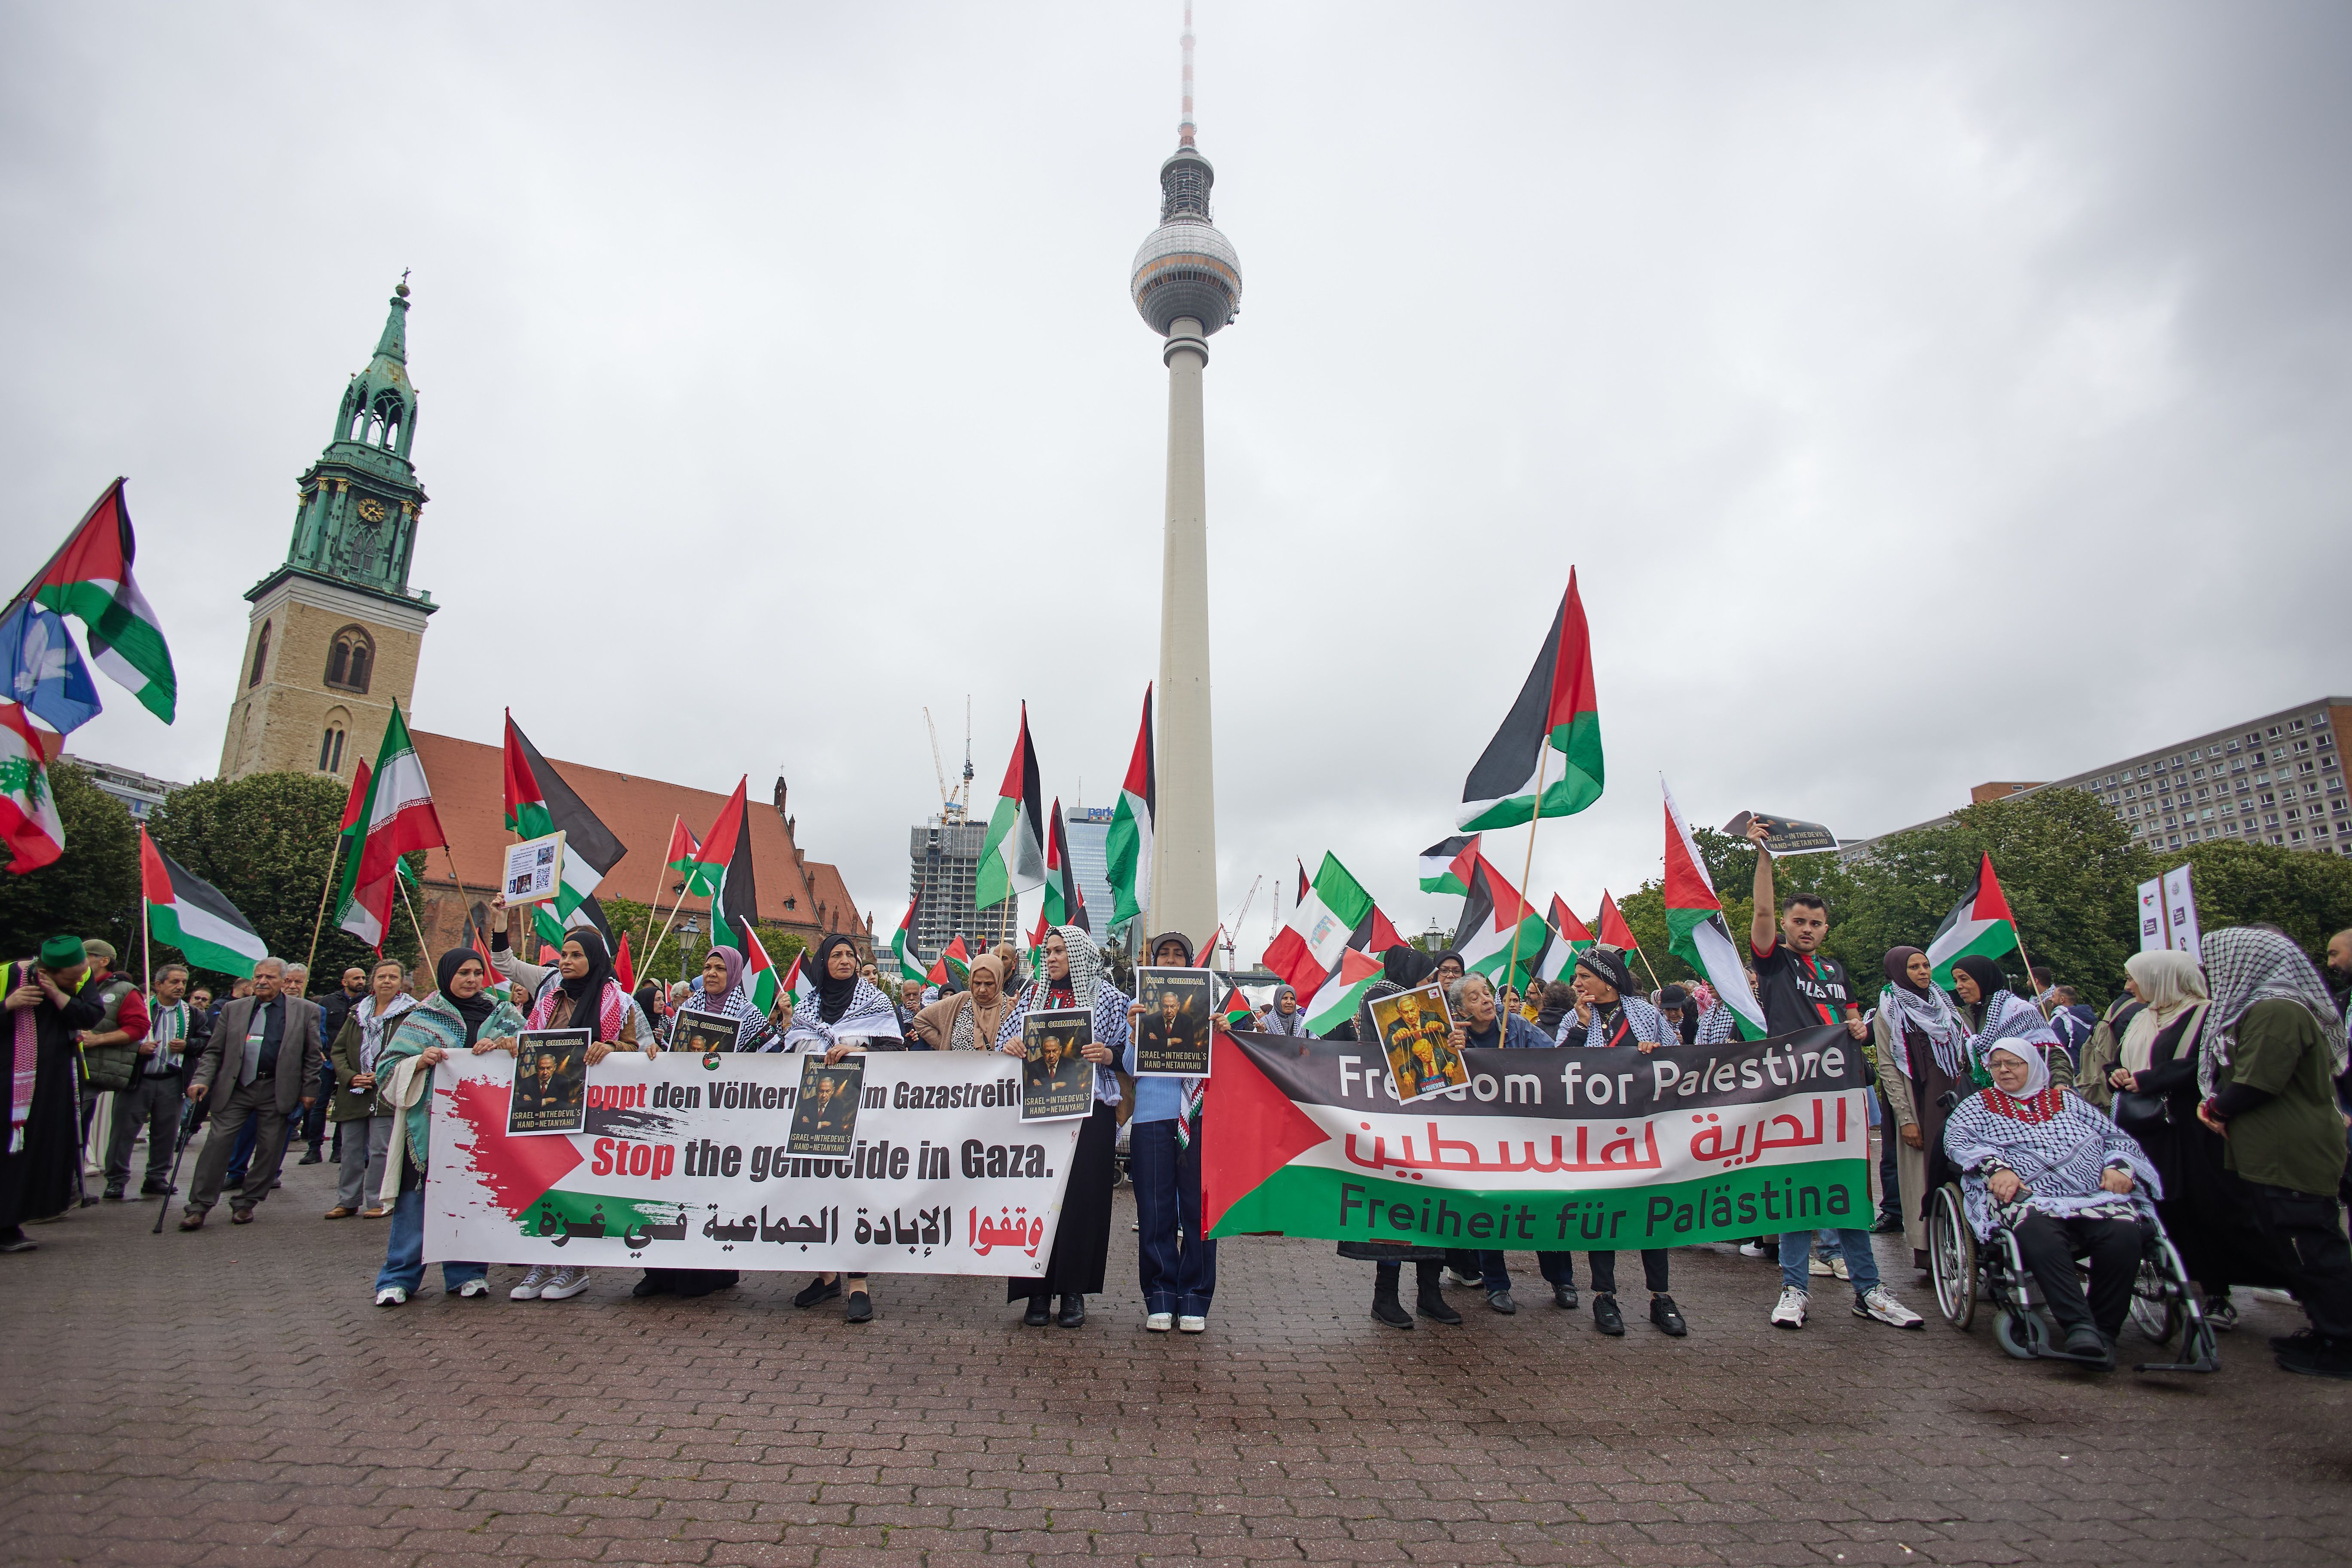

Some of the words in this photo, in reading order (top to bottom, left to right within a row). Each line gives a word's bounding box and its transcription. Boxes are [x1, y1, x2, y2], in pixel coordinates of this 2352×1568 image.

[1167, 977, 1205, 985] CRIMINAL
[546, 1038, 584, 1047] CRIMINAL
[683, 1018, 699, 1027] WAR
[700, 1021, 734, 1034] CRIMINAL
[1029, 1021, 1046, 1029] WAR
[1048, 1019, 1086, 1028] CRIMINAL
[1139, 1050, 1160, 1059] ISRAEL
[1339, 1055, 1542, 1104] From
[1560, 1061, 1633, 1105] for
[1651, 1042, 1845, 1101] Palestine
[587, 1083, 647, 1111] oppt
[652, 1081, 701, 1109] den
[708, 1081, 797, 1109] Völker
[894, 1078, 1021, 1109] Gazastreif
[1025, 1097, 1045, 1106] ISRAEL
[512, 1112, 534, 1120] ISRAEL
[1690, 1097, 1846, 1168] الحرية
[790, 1133, 809, 1141] ISRAEL
[1344, 1121, 1662, 1180] لفلسطين
[591, 1137, 675, 1180] Stop
[685, 1139, 741, 1177] the
[918, 1140, 949, 1179] in
[962, 1139, 1053, 1178] Gaza.
[538, 1201, 606, 1247] غزة
[1339, 1182, 1537, 1240] Freiheit
[1556, 1201, 1626, 1240] für
[1646, 1177, 1850, 1237] Palästina
[624, 1202, 688, 1259] في
[702, 1203, 839, 1253] الجماعية
[854, 1206, 951, 1258] الإبادة
